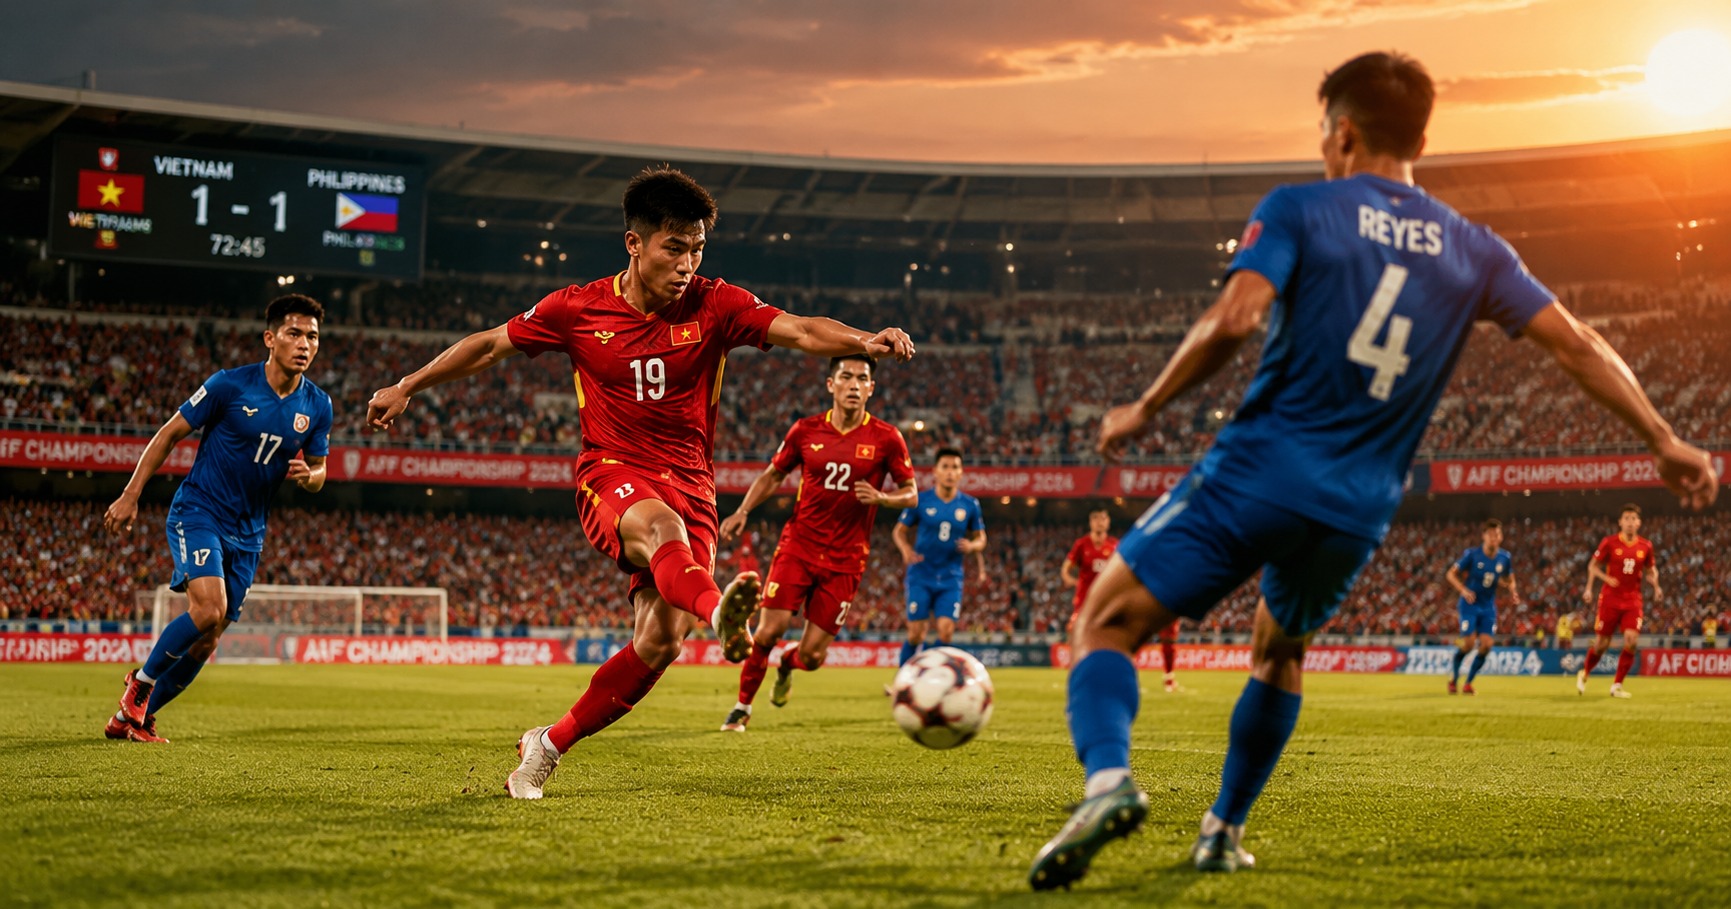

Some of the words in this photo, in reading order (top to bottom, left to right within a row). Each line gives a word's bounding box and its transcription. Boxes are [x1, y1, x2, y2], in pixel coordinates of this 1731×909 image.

[154, 156, 233, 180] VIETNAM
[191, 184, 209, 226] 1
[269, 191, 287, 232] 1
[210, 234, 265, 258] 72:45
[1358, 204, 1443, 257] REYES
[1346, 262, 1413, 401] 4
[630, 357, 666, 401] 19
[254, 432, 283, 465] 17
[824, 462, 852, 492] 22
[938, 521, 951, 542] 8
